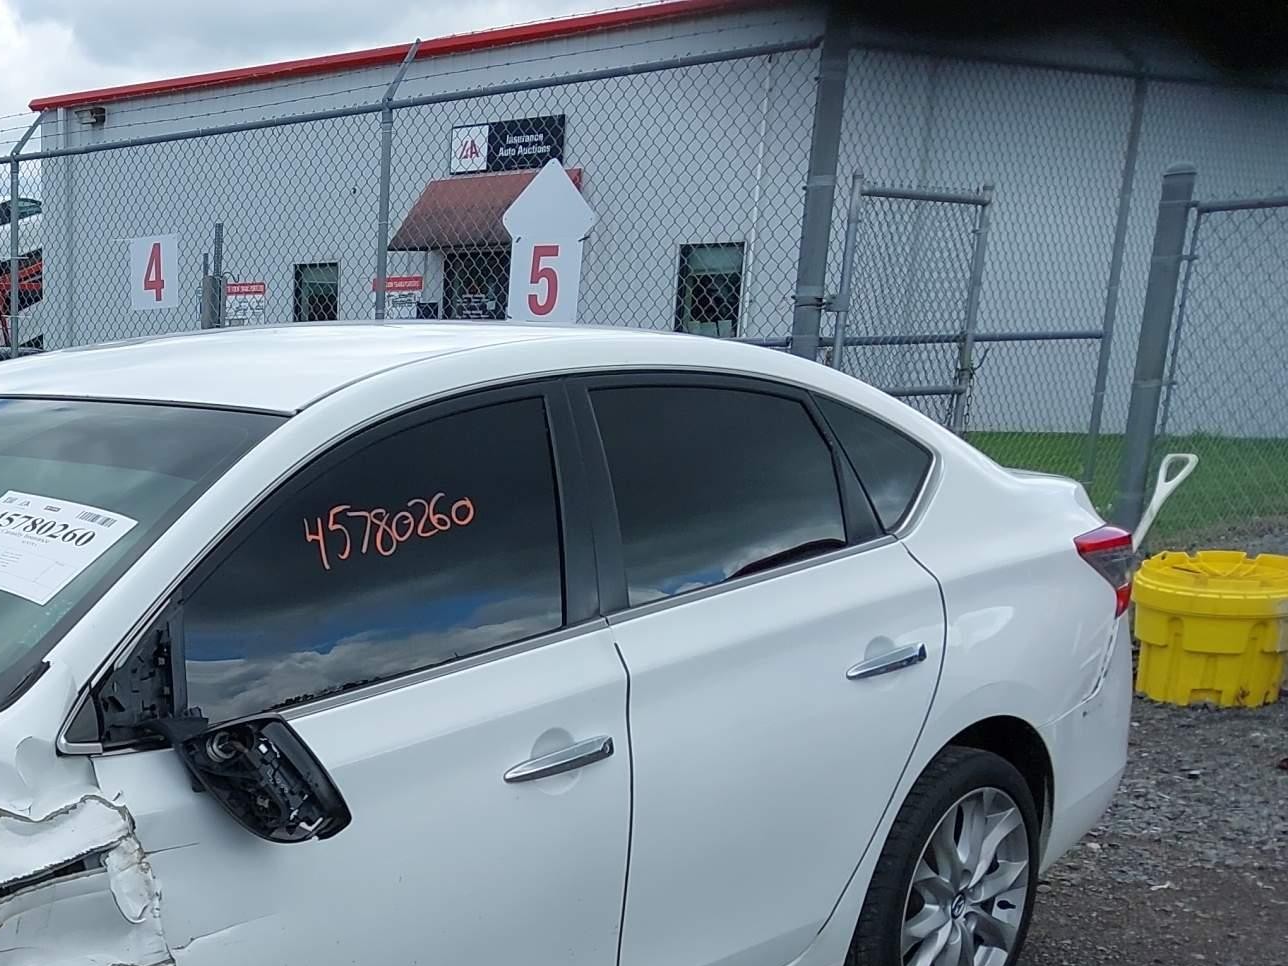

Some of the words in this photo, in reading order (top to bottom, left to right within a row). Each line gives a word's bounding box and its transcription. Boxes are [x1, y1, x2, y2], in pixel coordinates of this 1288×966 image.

[499, 147, 516, 157] Auto
[517, 144, 551, 156] Auctions
[506, 132, 544, 145] Insurance
[142, 241, 165, 303] 4
[527, 244, 561, 317] 5
[303, 491, 475, 571] 45780260
